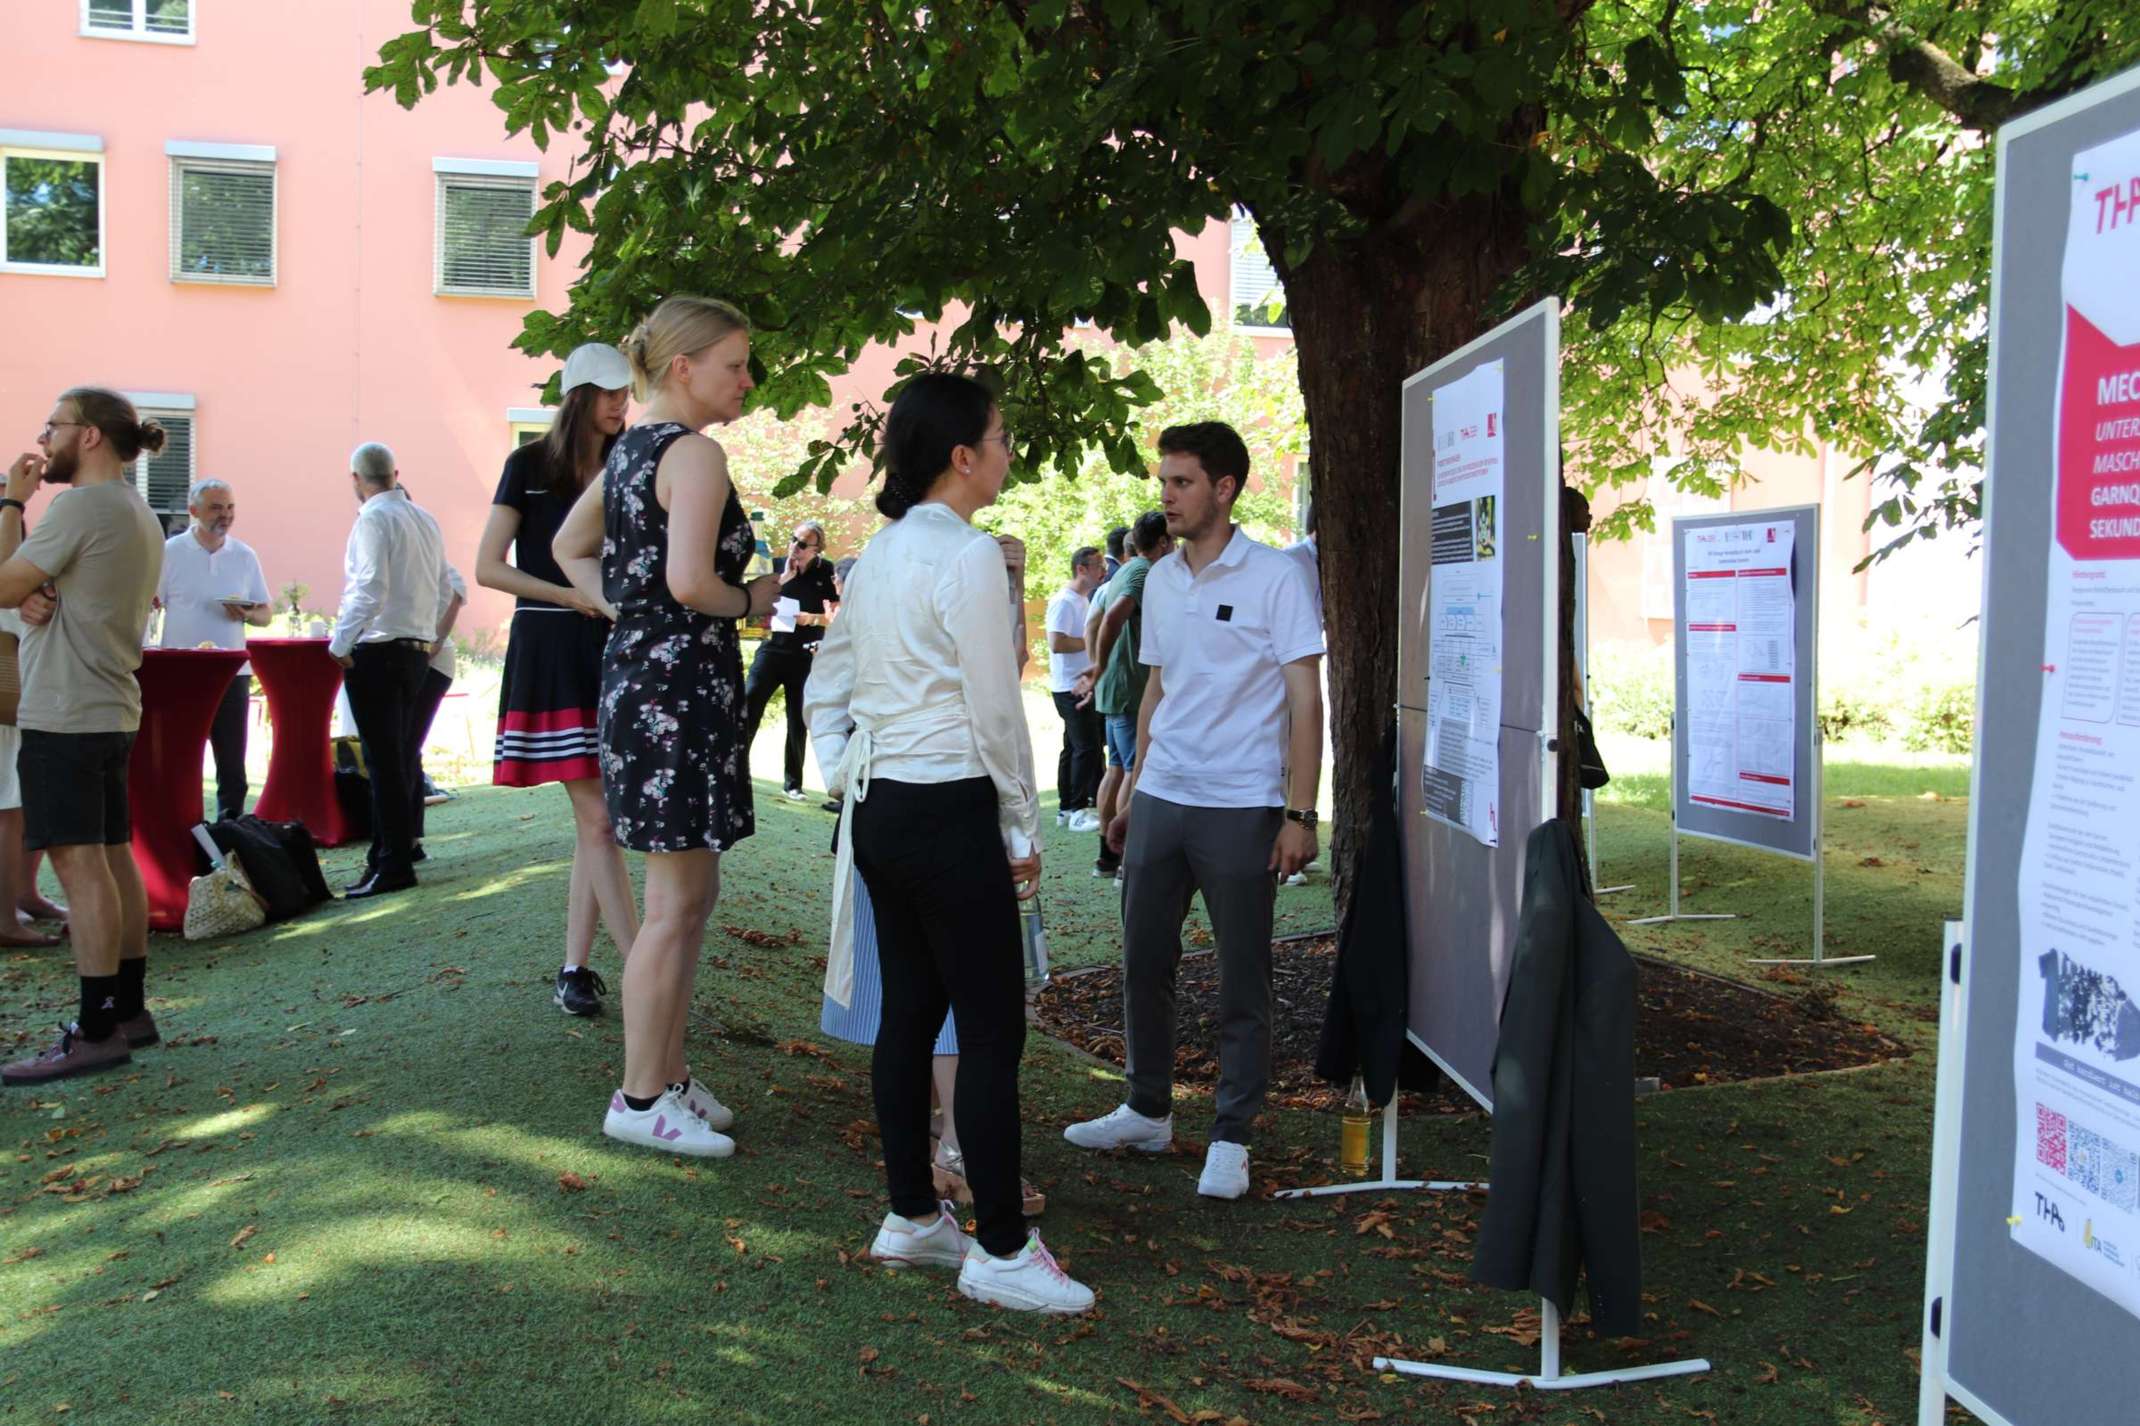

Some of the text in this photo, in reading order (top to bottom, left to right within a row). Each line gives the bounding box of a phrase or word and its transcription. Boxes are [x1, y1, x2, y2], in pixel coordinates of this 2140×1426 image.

[2097, 371, 2140, 405] MEC
[2093, 451, 2140, 474] MASCH
[2090, 484, 2140, 506] GARNQ
[2089, 518, 2140, 539] SEKUND
